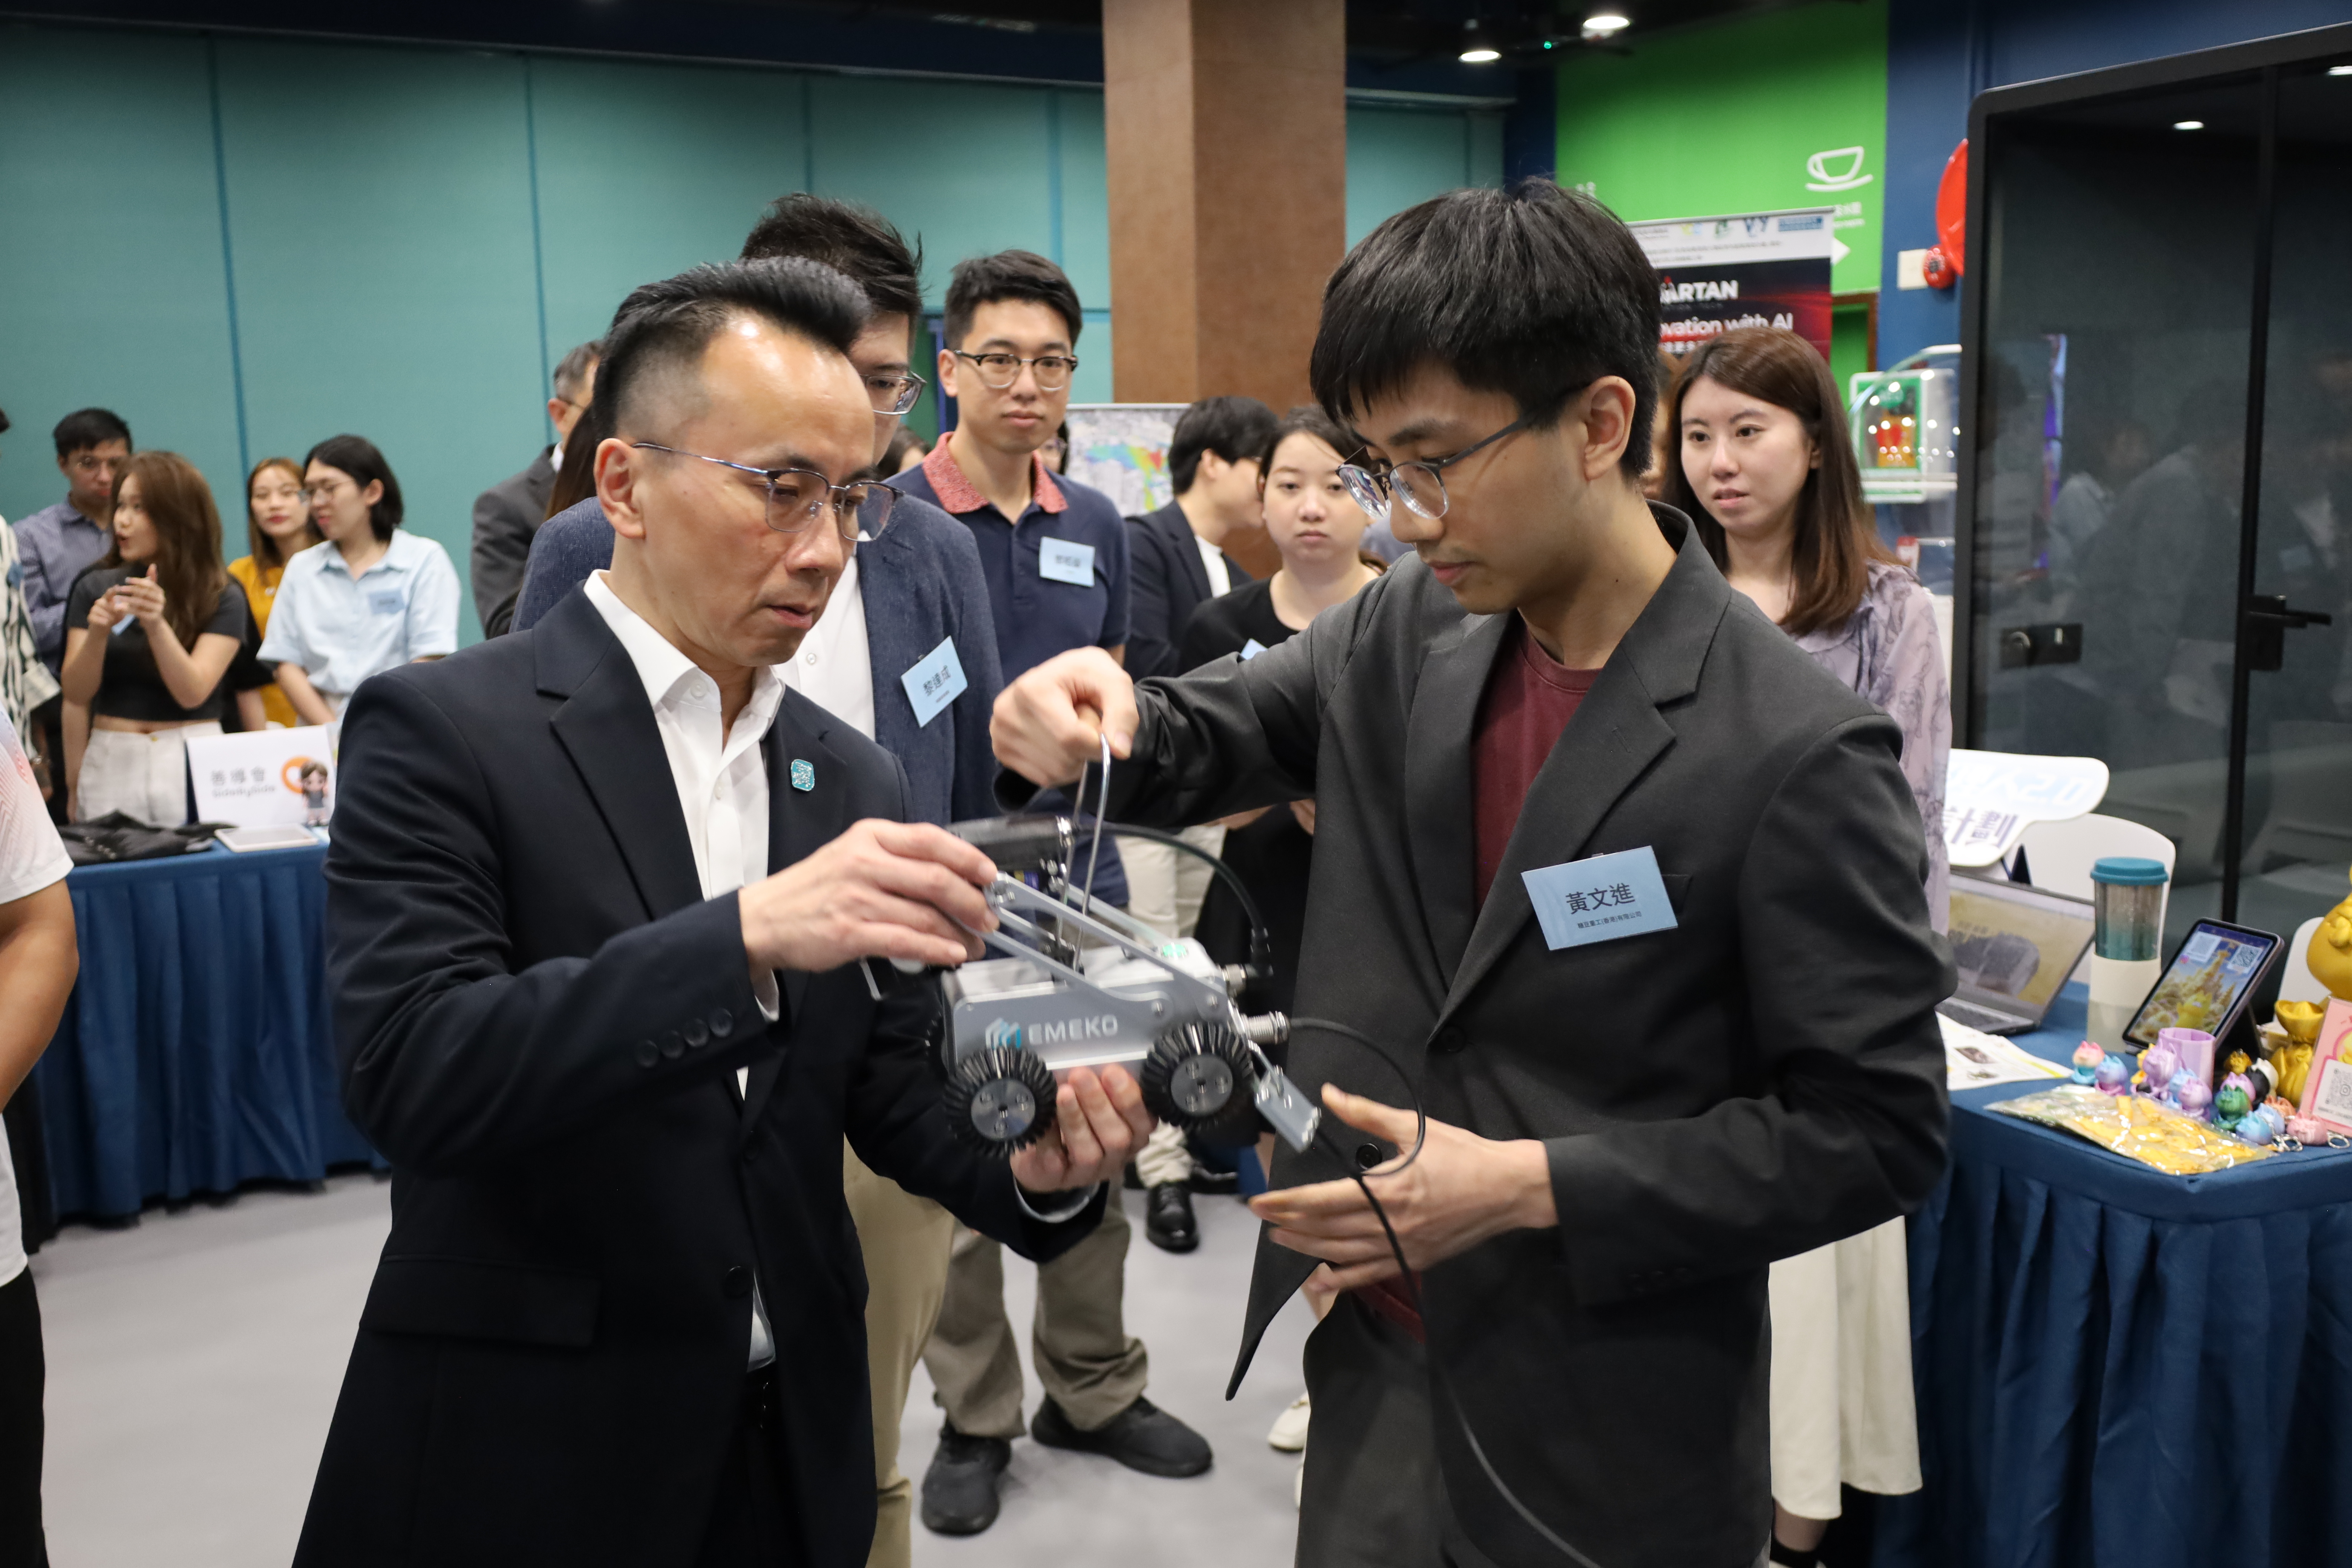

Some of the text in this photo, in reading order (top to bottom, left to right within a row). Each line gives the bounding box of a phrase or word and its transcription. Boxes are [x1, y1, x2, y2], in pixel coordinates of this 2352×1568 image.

[1565, 883, 1635, 914] 黃文進
[1028, 1015, 1118, 1045] EMEKO
